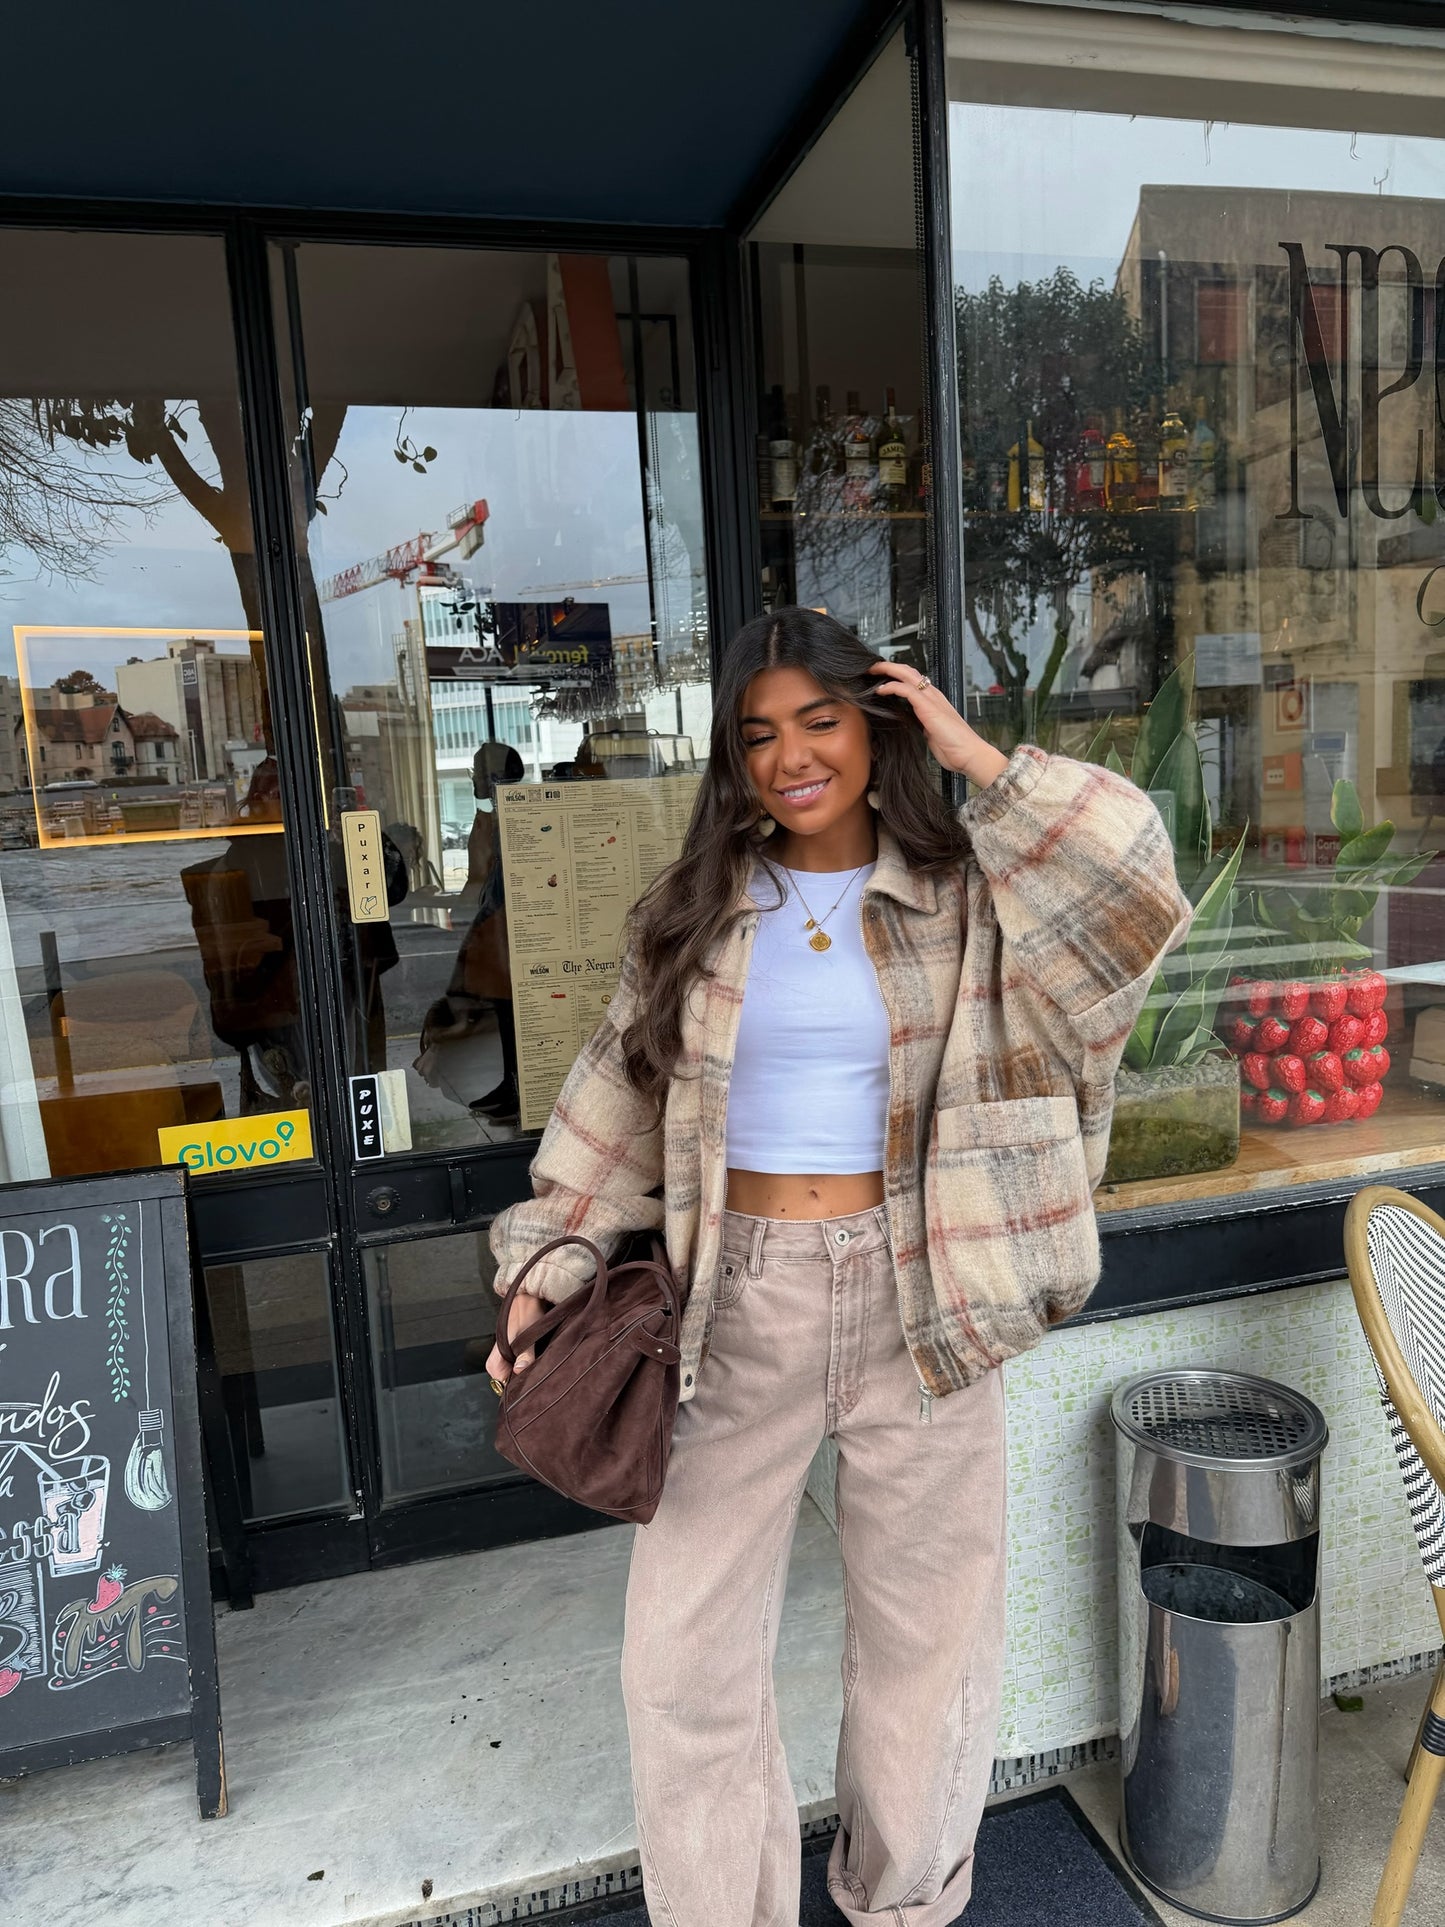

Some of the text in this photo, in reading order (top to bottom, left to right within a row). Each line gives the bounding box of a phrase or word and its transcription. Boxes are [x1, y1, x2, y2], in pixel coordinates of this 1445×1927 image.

[1275, 242, 1445, 519] Ne
[357, 823, 371, 889] Puxar
[561, 960, 582, 976] The
[585, 958, 616, 976] Negra
[359, 1089, 375, 1146] PUXE
